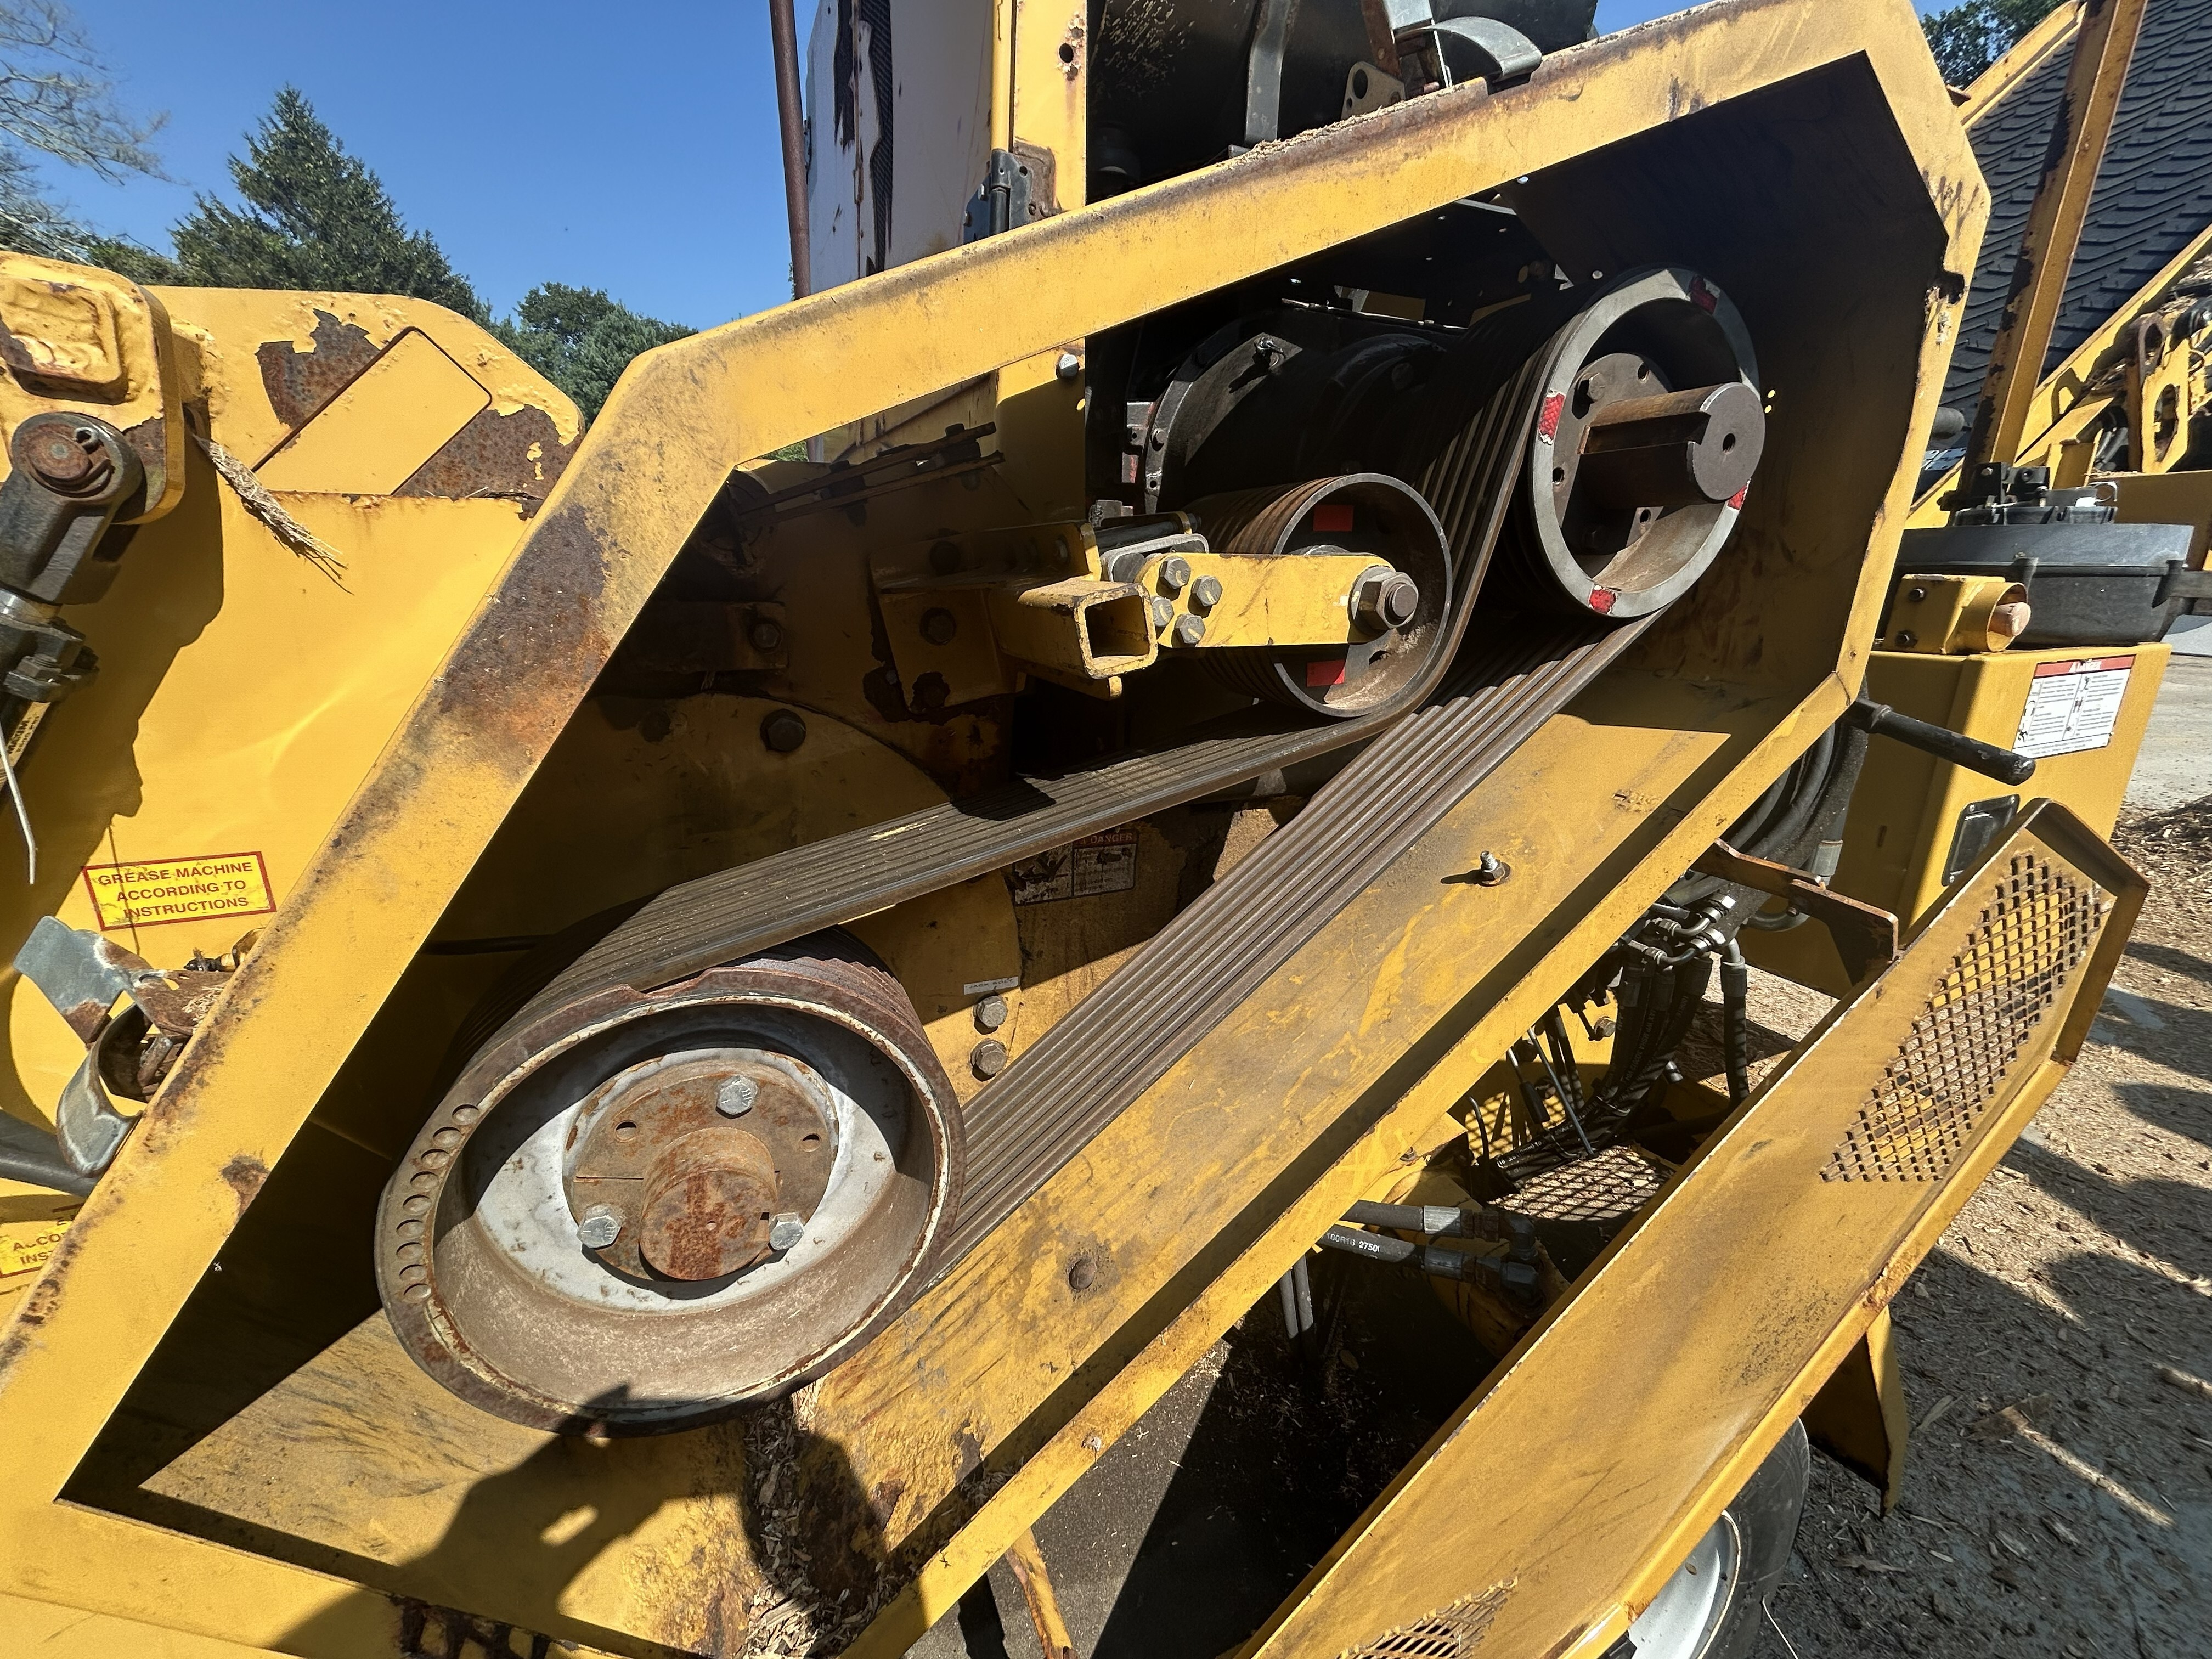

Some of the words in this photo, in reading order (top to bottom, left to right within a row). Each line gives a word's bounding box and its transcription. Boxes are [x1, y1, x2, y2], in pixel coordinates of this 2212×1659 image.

[1091, 832, 1133, 844] DANGER
[99, 870, 171, 885] GREASE
[176, 862, 253, 879] MACHINE
[117, 883, 219, 901] ACCORDING
[223, 879, 246, 890] TO
[124, 897, 249, 917] INSTRUCTIONS
